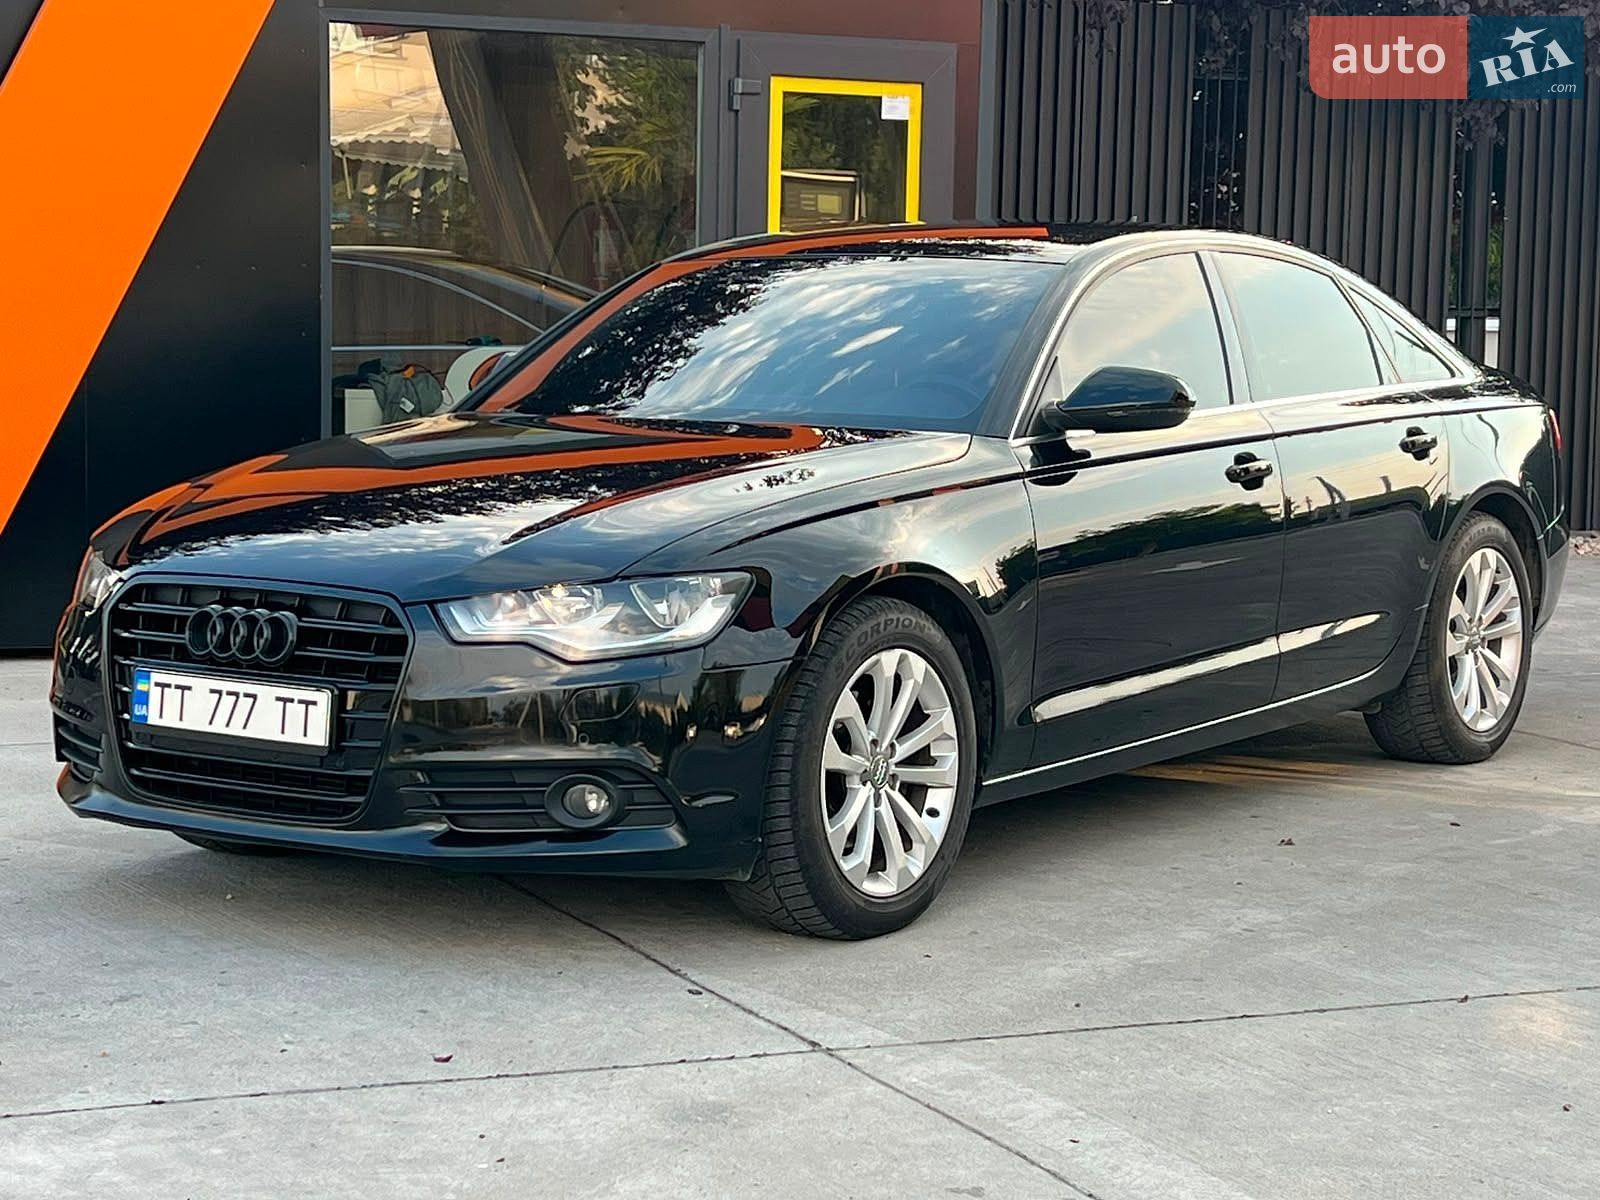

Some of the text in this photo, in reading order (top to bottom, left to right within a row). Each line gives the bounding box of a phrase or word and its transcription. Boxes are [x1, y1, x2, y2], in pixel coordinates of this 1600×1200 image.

[134, 703, 148, 716] UA
[154, 681, 318, 738] TT 777 TT
